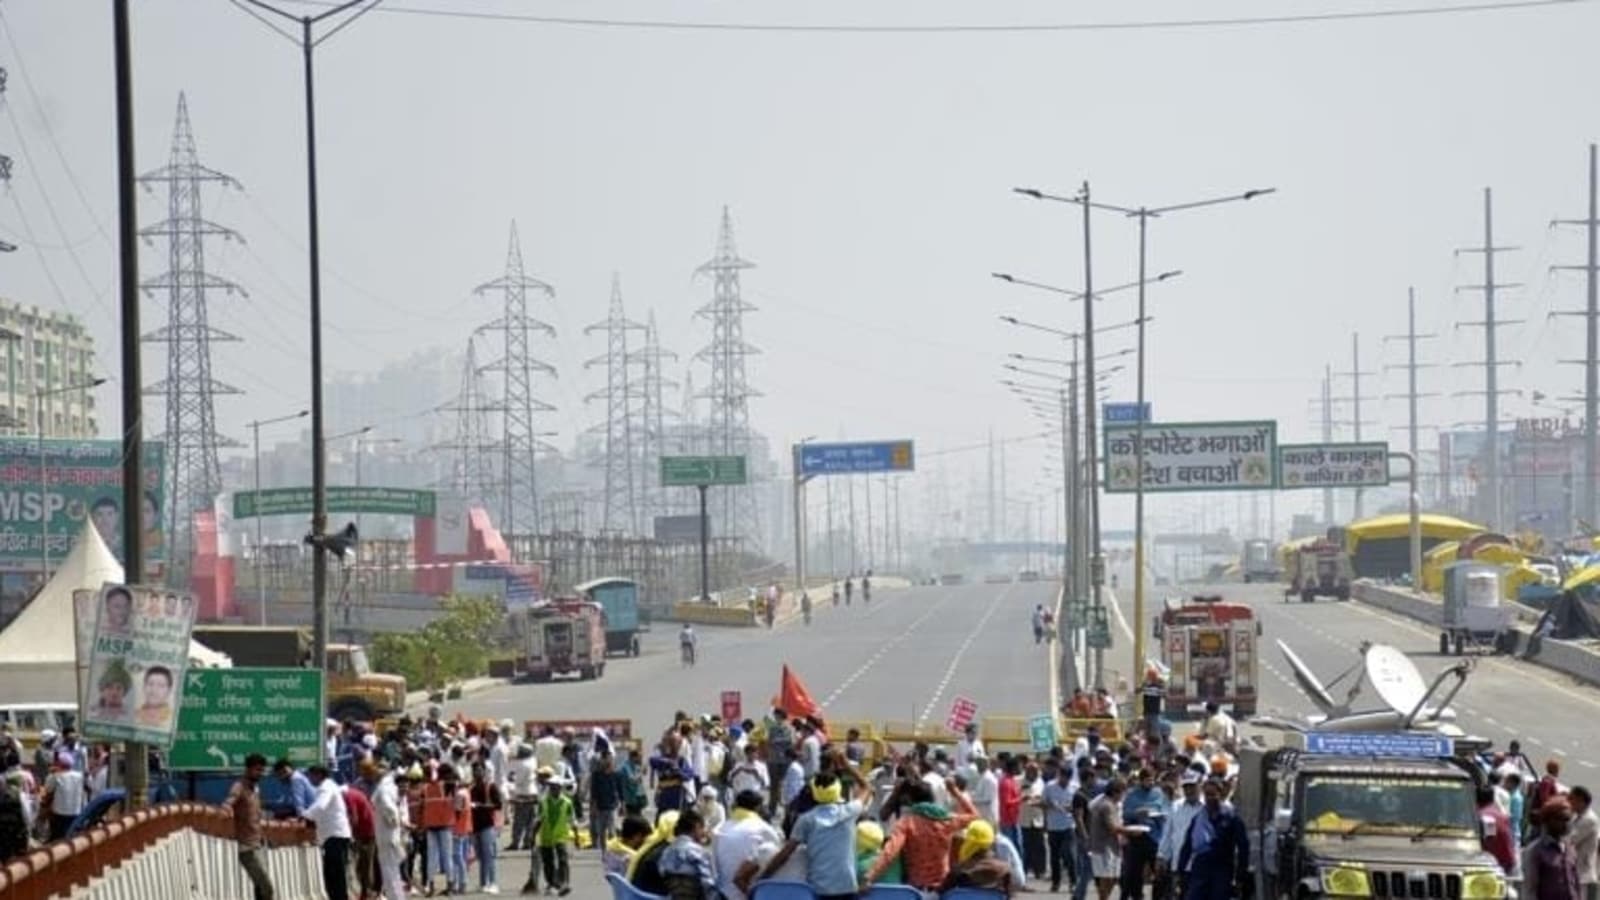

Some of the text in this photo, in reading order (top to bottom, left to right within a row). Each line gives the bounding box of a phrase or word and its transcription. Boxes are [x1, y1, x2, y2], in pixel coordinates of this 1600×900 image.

[0, 491, 65, 522] MSP
[97, 636, 134, 655] MSP
[245, 714, 287, 724] AIRPORT
[259, 731, 317, 742] GHAZIABAD
